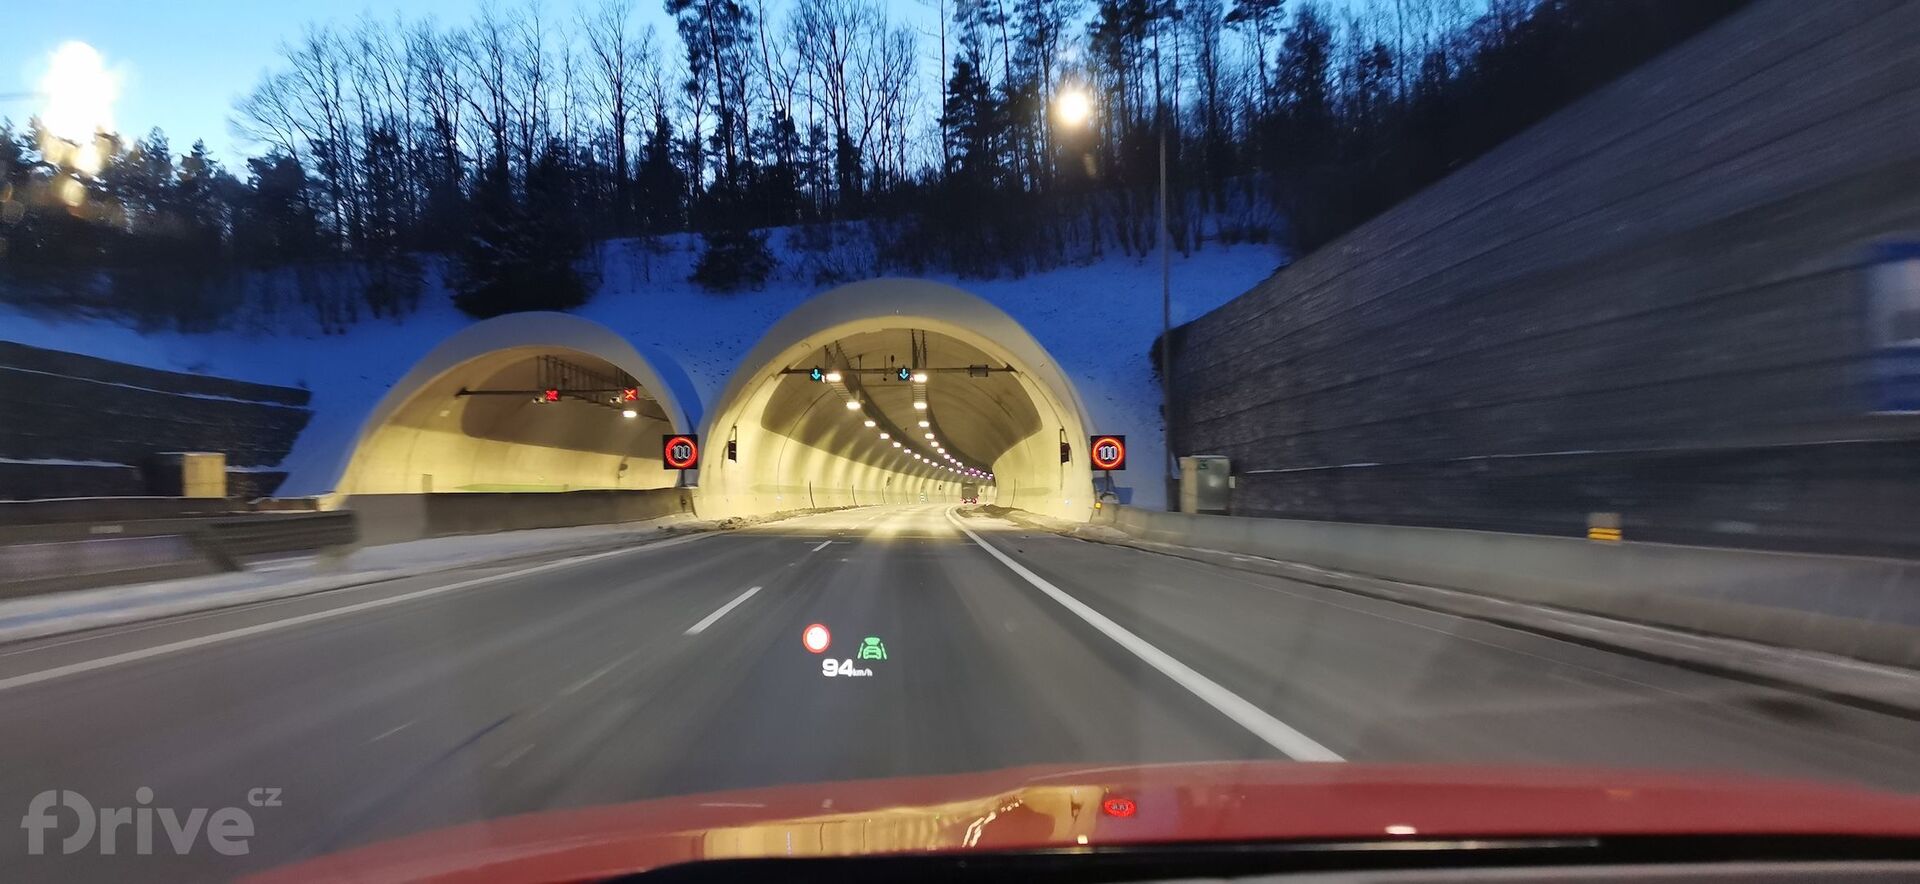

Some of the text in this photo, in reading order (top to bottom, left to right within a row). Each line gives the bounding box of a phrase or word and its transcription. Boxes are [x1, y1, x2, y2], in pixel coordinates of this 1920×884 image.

[672, 445, 690, 459] 100
[1098, 446, 1118, 460] 100
[822, 658, 853, 677] 94
